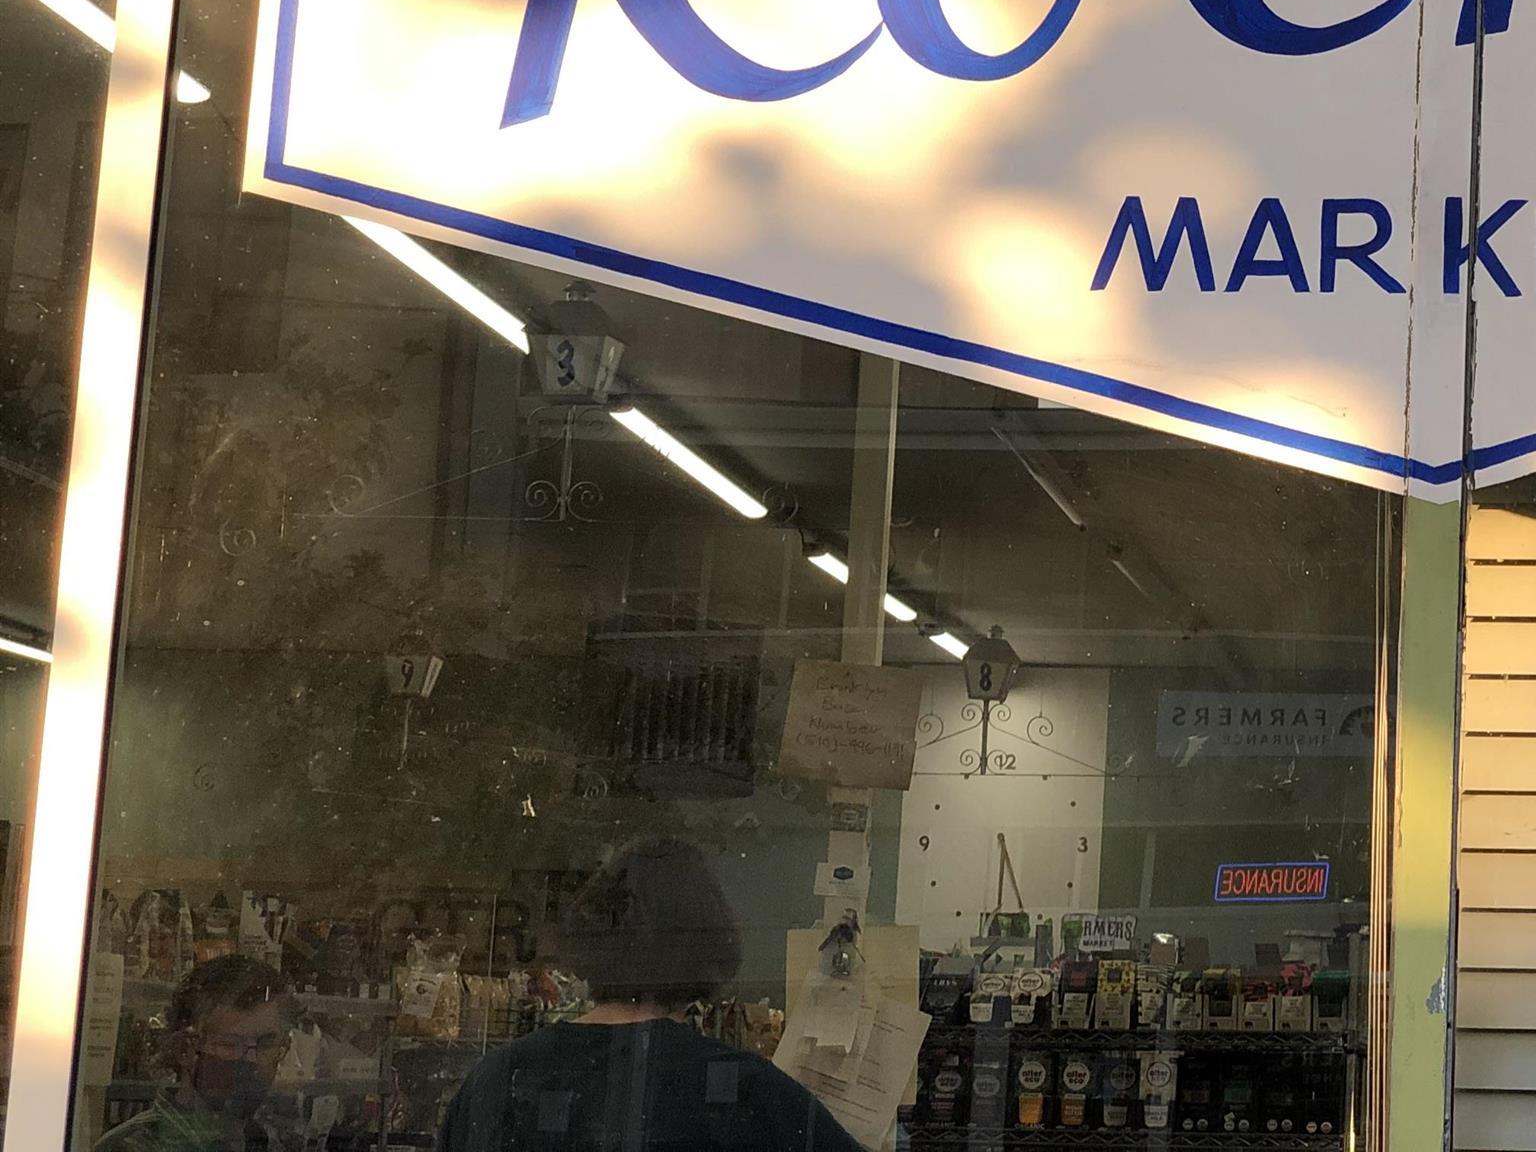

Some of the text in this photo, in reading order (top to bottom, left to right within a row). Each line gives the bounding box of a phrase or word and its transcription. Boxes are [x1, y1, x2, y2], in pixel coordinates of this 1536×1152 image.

[557, 339, 576, 387] 3
[979, 662, 992, 692] 8
[997, 754, 1017, 770] 12
[918, 834, 930, 852] 9
[1076, 836, 1089, 853] 3
